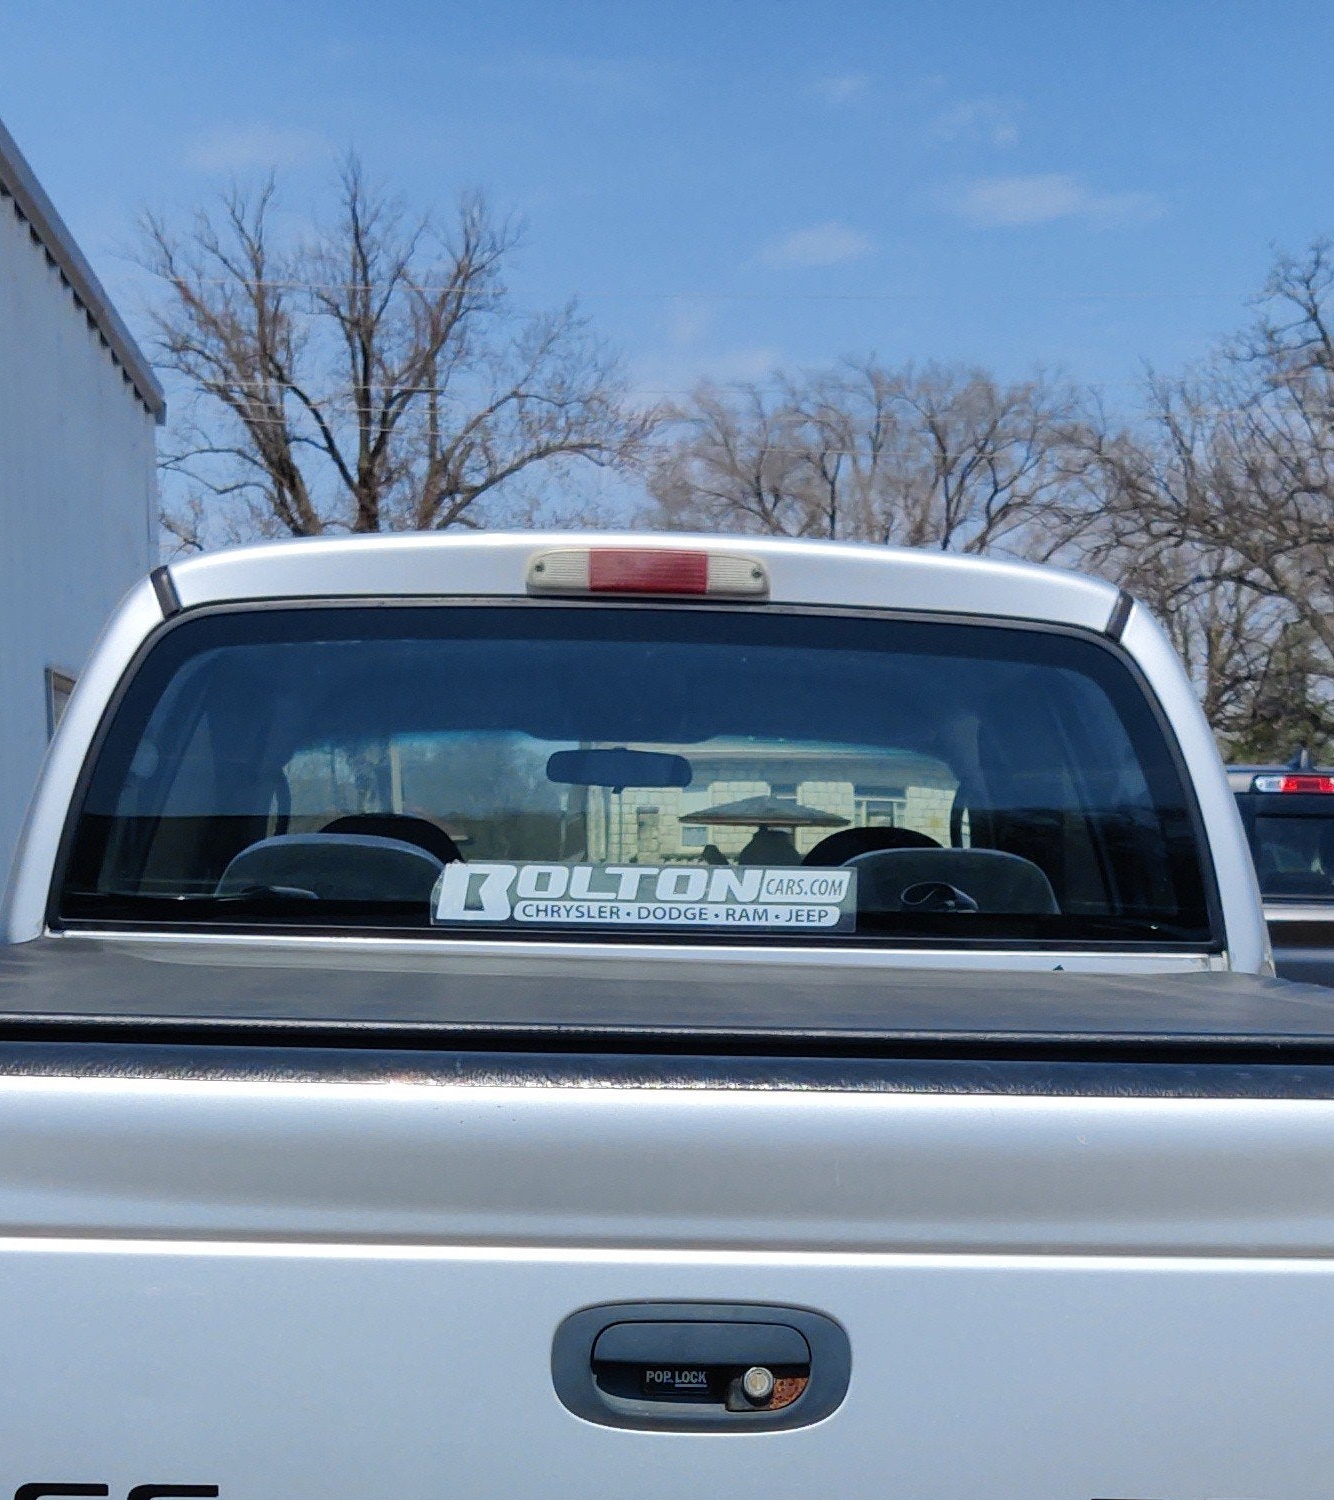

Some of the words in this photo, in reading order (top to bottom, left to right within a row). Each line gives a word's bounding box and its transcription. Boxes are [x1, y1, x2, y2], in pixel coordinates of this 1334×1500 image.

[436, 864, 762, 921] BOLTON
[766, 877, 844, 897] CARS.COM
[522, 903, 621, 919] CHRYSLER
[637, 906, 709, 921] DODGE
[725, 909, 768, 922] RAM
[785, 909, 829, 923] JEEP
[675, 1371, 707, 1384] LOCK
